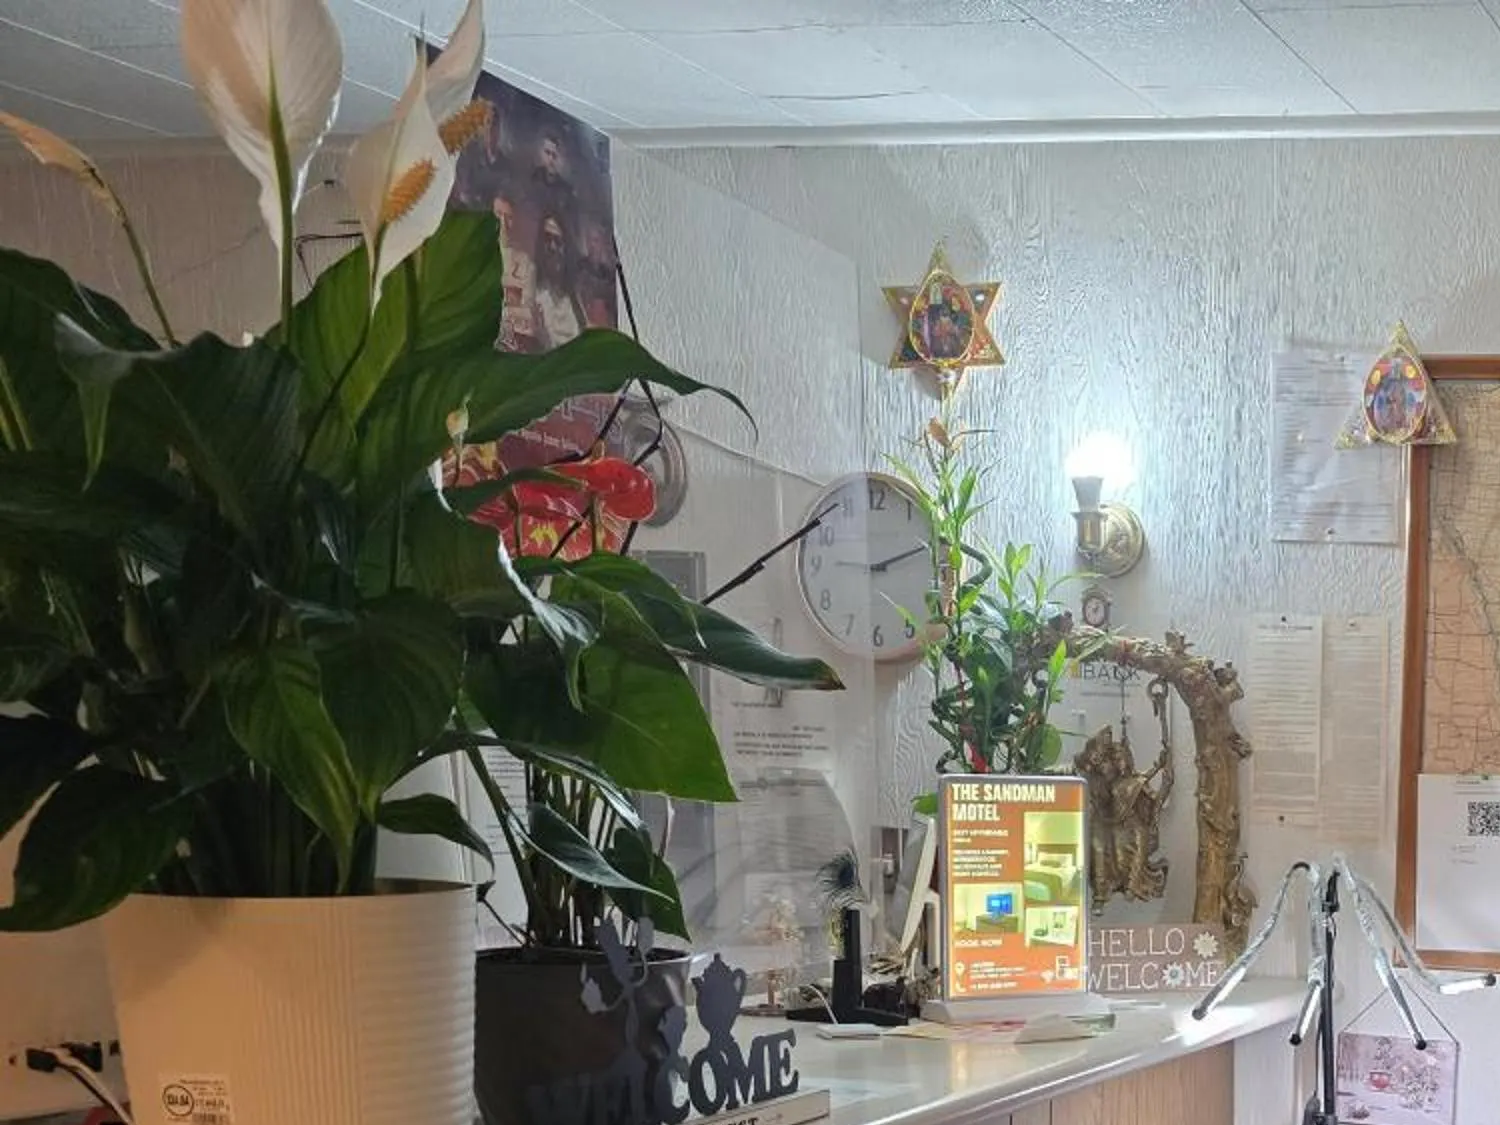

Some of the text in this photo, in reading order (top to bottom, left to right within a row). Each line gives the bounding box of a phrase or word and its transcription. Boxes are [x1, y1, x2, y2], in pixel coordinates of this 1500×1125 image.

[869, 488, 886, 511] 12
[820, 588, 831, 611] 8
[872, 624, 884, 648] 6
[952, 783, 1056, 803] THE SANDMAN
[952, 803, 1001, 822] MOTEL
[1087, 926, 1186, 958] HELLO
